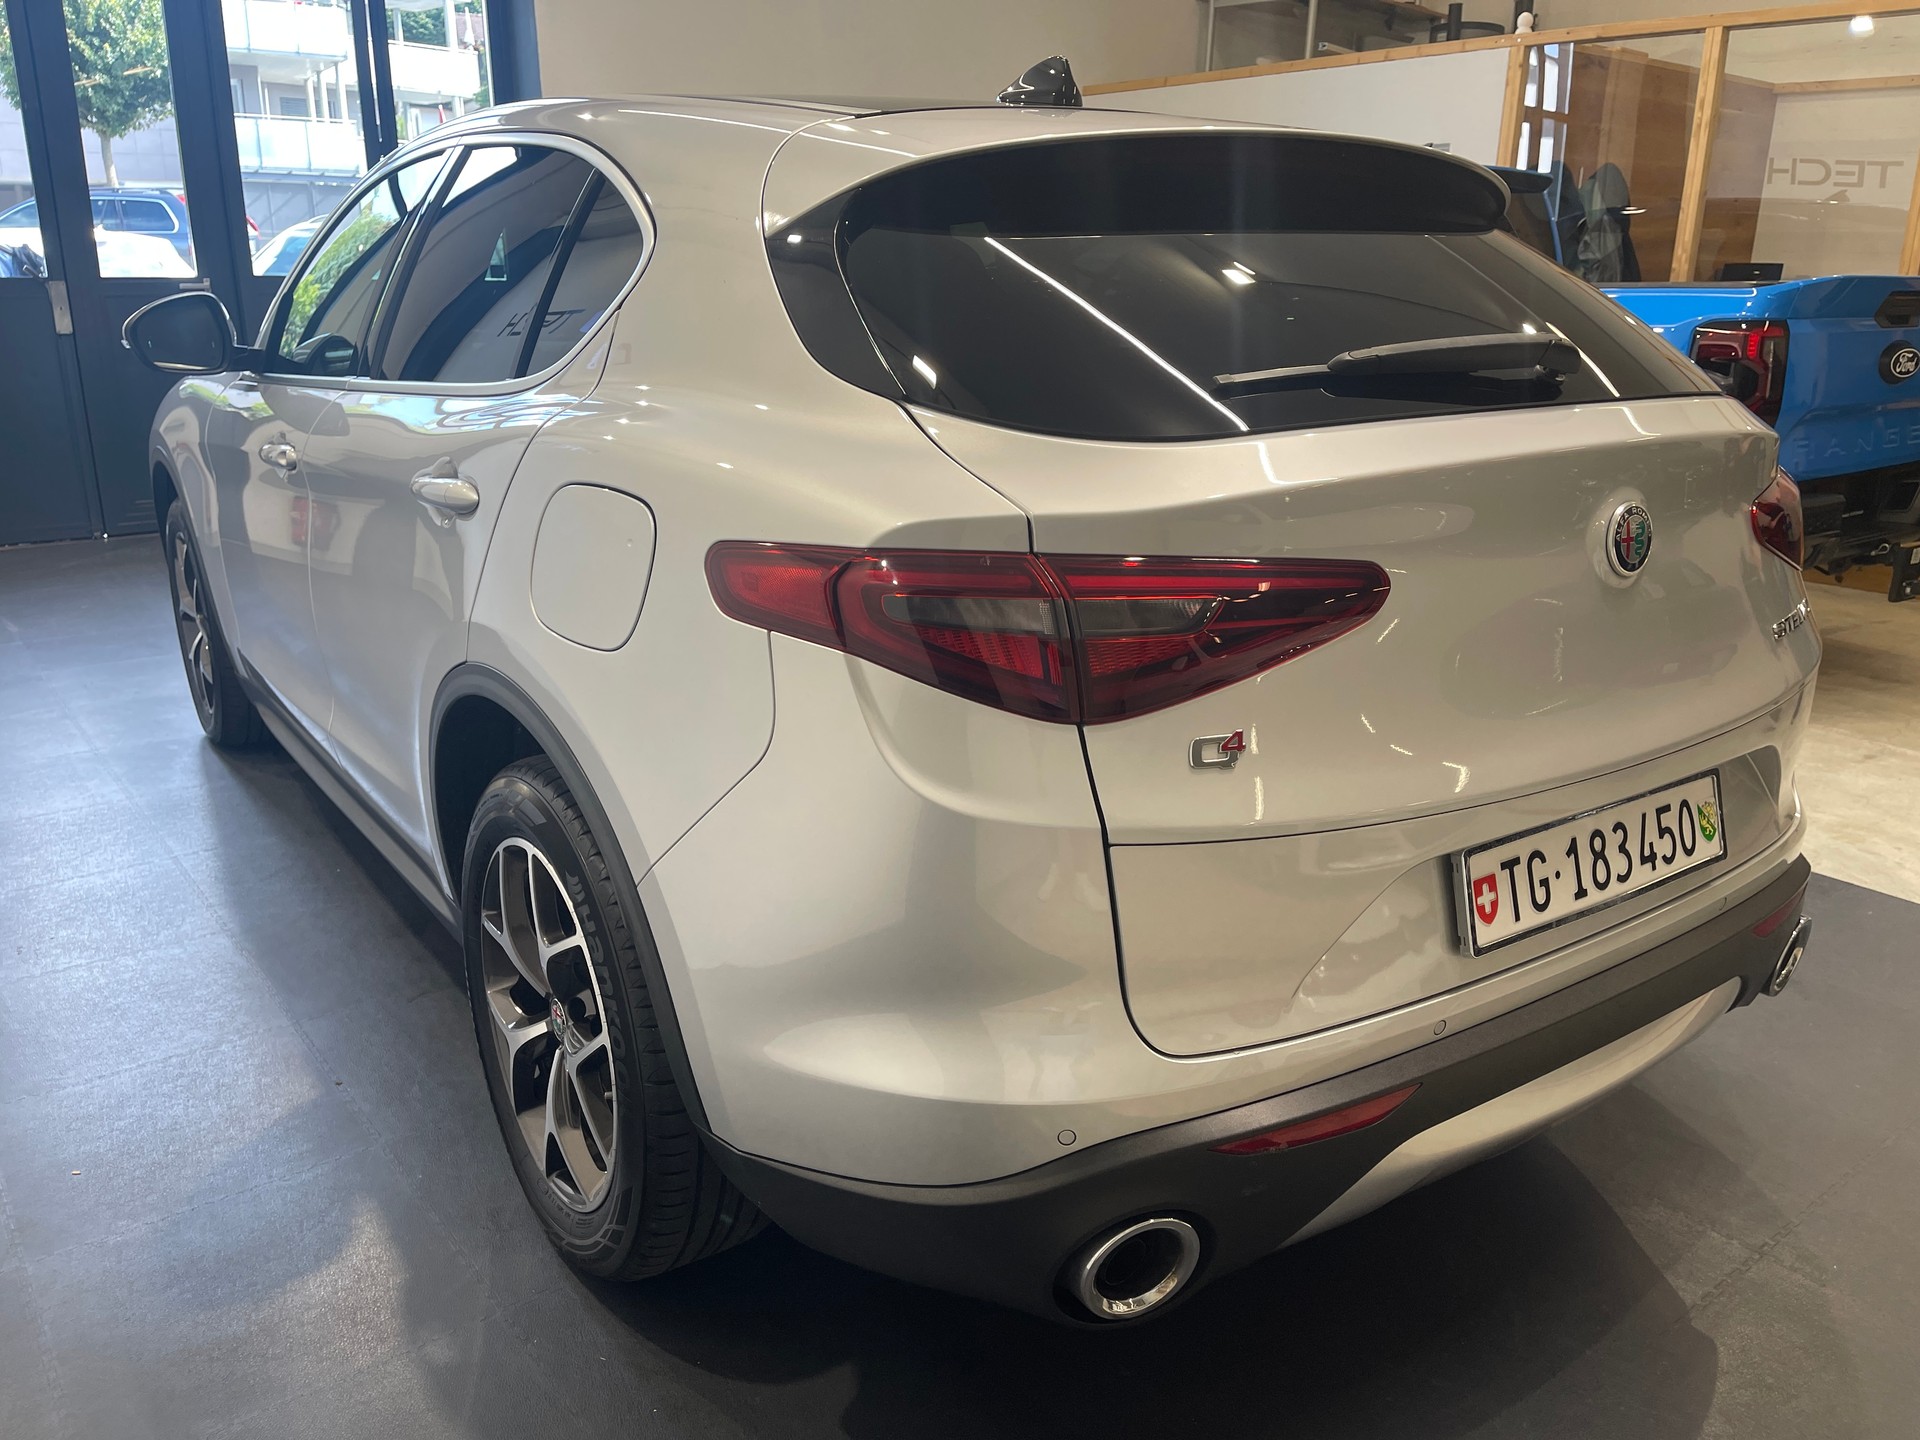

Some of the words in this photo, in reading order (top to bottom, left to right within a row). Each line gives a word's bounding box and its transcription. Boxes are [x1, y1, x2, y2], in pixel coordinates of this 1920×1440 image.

[1895, 352, 1918, 373] Ford
[1616, 512, 1630, 542] ALFA
[1188, 728, 1246, 770] Q4
